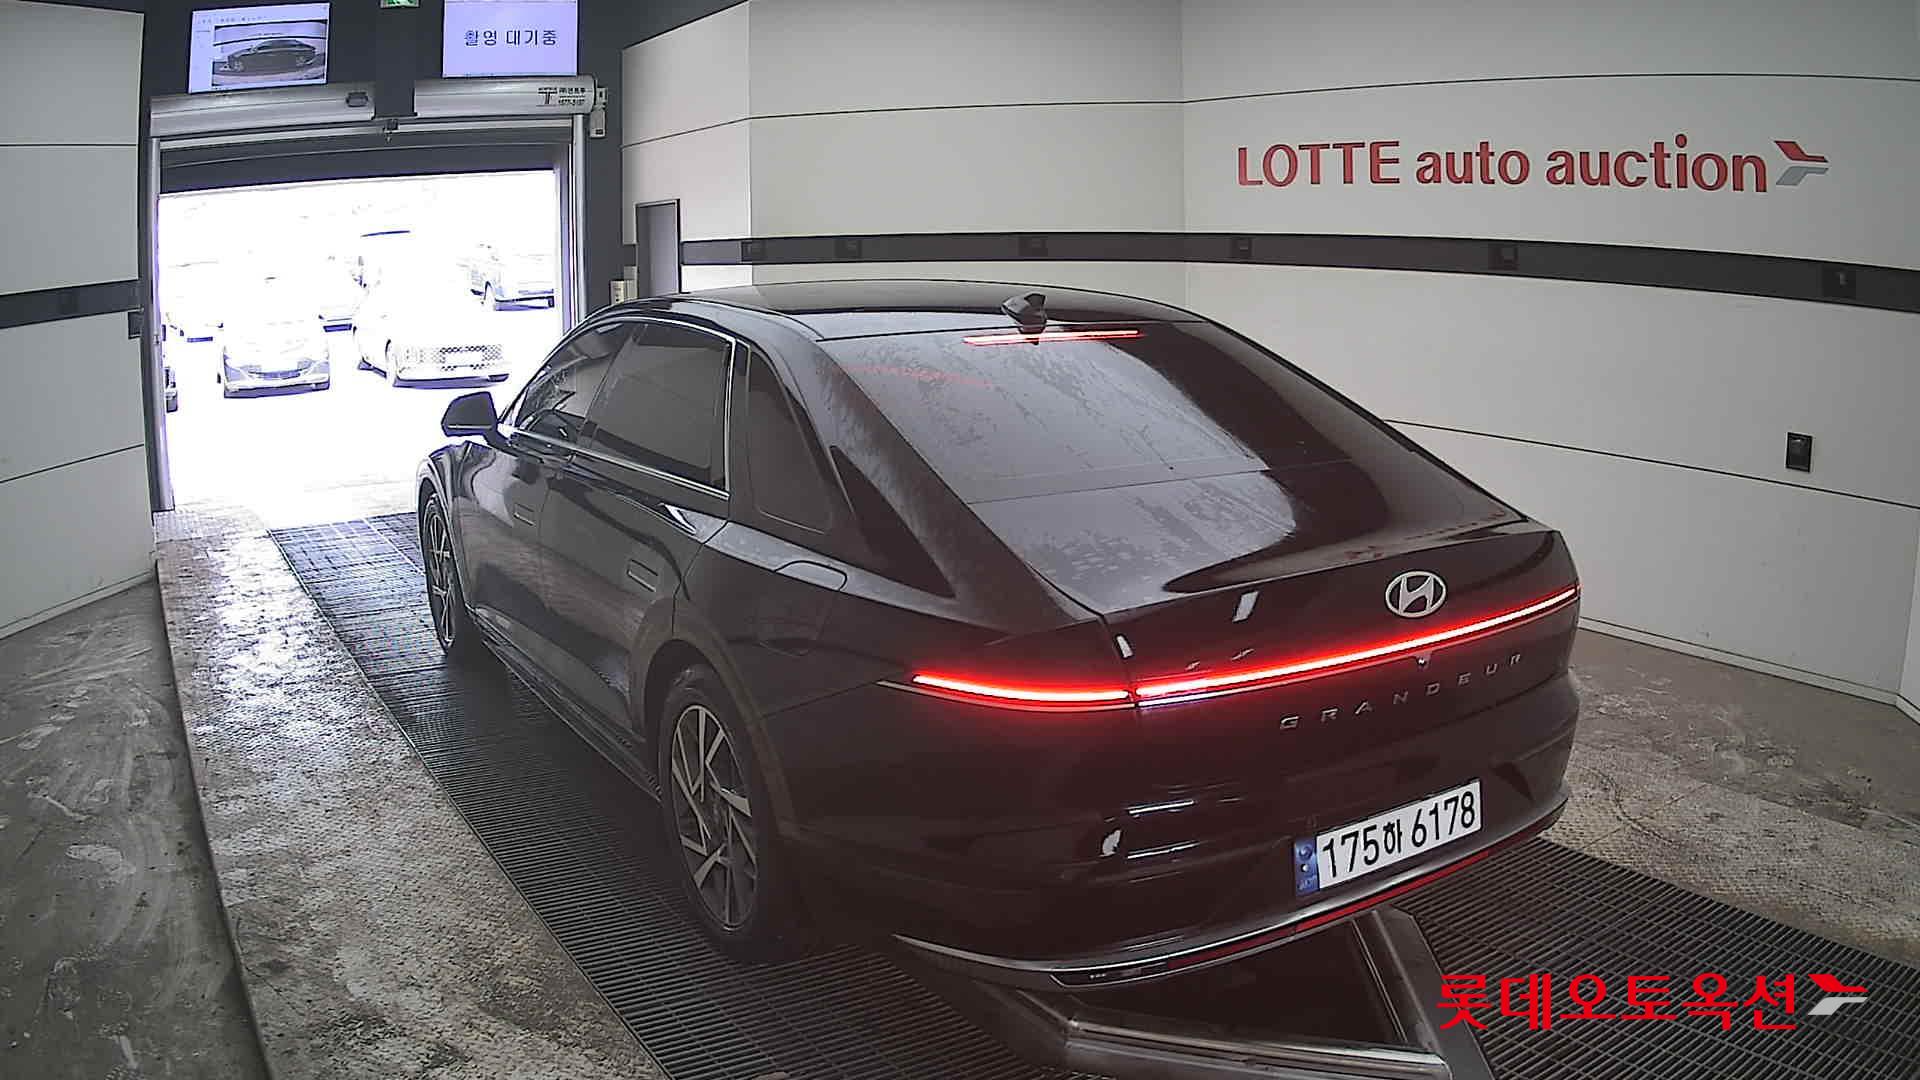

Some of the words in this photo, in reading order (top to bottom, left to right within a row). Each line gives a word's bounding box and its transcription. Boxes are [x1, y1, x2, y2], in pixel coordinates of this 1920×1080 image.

[505, 29, 558, 46] 대기중
[1237, 140, 1401, 188] LOTTE
[1414, 140, 1532, 187] auto
[1544, 132, 1768, 194] auction
[1279, 653, 1521, 730] GRANDEUR
[1321, 818, 1403, 878] 175하
[1411, 790, 1476, 848] 6178
